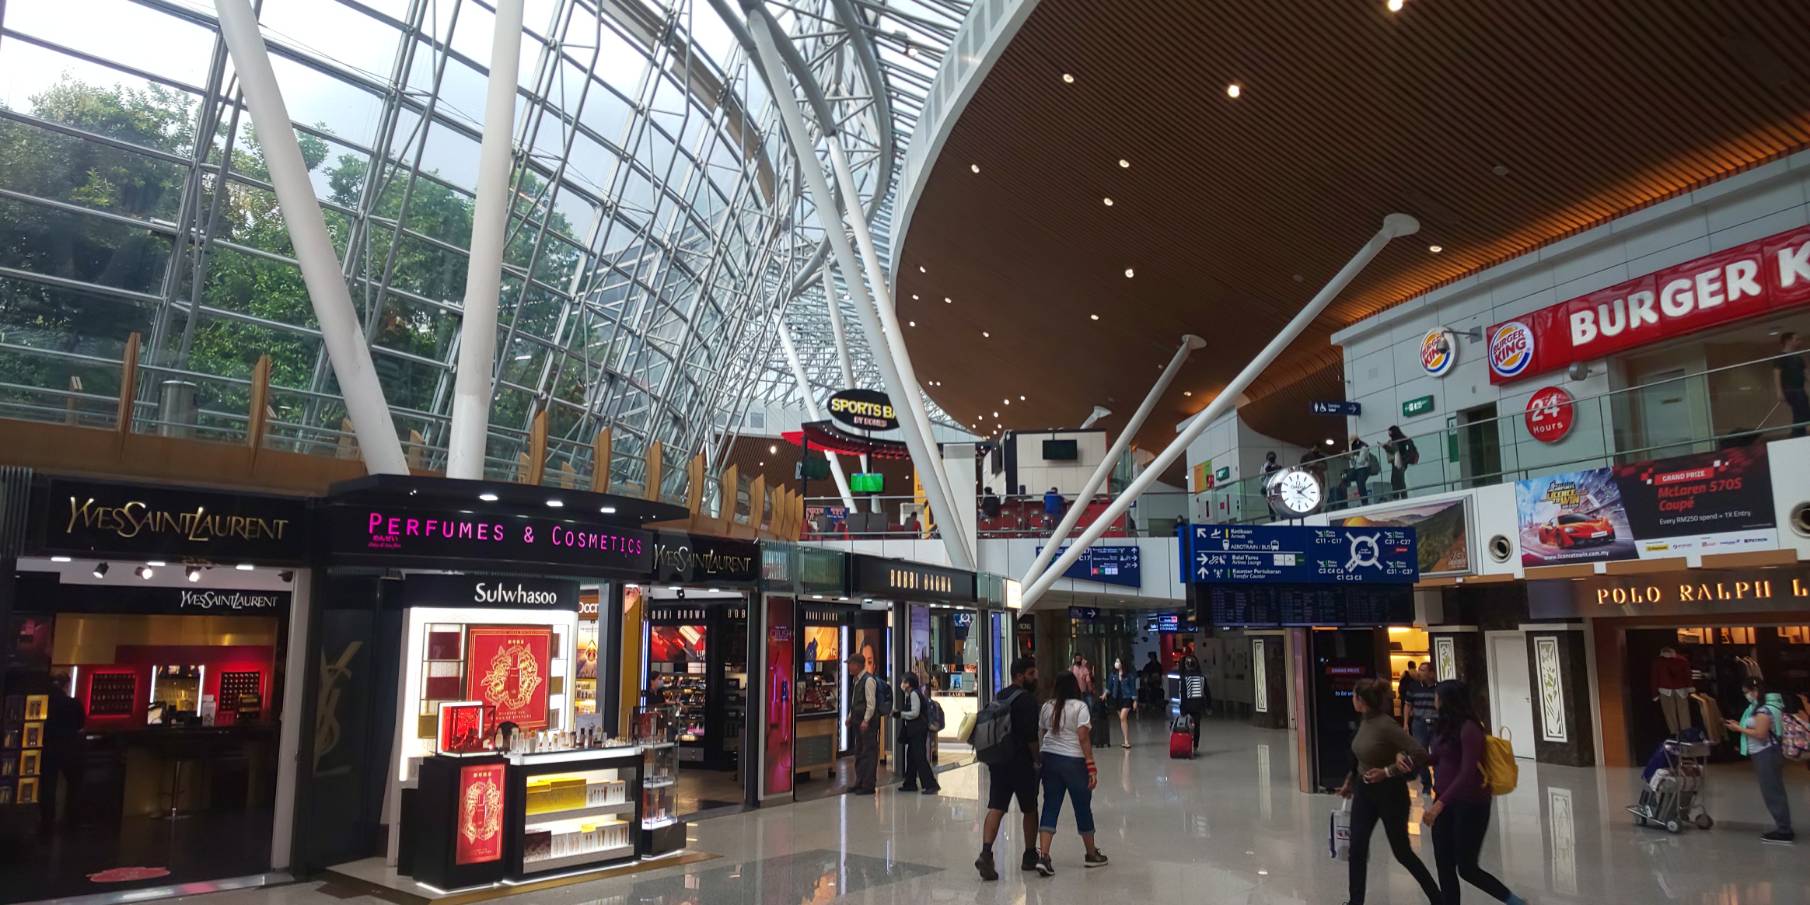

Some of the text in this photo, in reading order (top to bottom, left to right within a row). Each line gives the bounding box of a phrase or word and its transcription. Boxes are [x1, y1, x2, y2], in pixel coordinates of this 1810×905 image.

[1569, 240, 1810, 348] BURGER K
[1493, 328, 1525, 355] BURGER
[1494, 337, 1527, 368] KING
[831, 397, 882, 417] SPORTS
[1531, 392, 1560, 422] 24
[1532, 421, 1564, 433] Hours
[1657, 478, 1743, 498] McLaren 570S
[1662, 470, 1706, 482] GRAND PRIZE
[1658, 496, 1696, 512] Coupé
[1659, 517, 1676, 526] Every
[1676, 514, 1699, 524] RM250
[1699, 513, 1718, 522] spend
[1733, 510, 1752, 518] Entry
[368, 512, 642, 555] PERFUMES & COSMETICS
[890, 568, 952, 593] BOBBI BROWN
[1596, 577, 1809, 605] POLO RALPH L
[474, 582, 557, 605] Sulwhasoo
